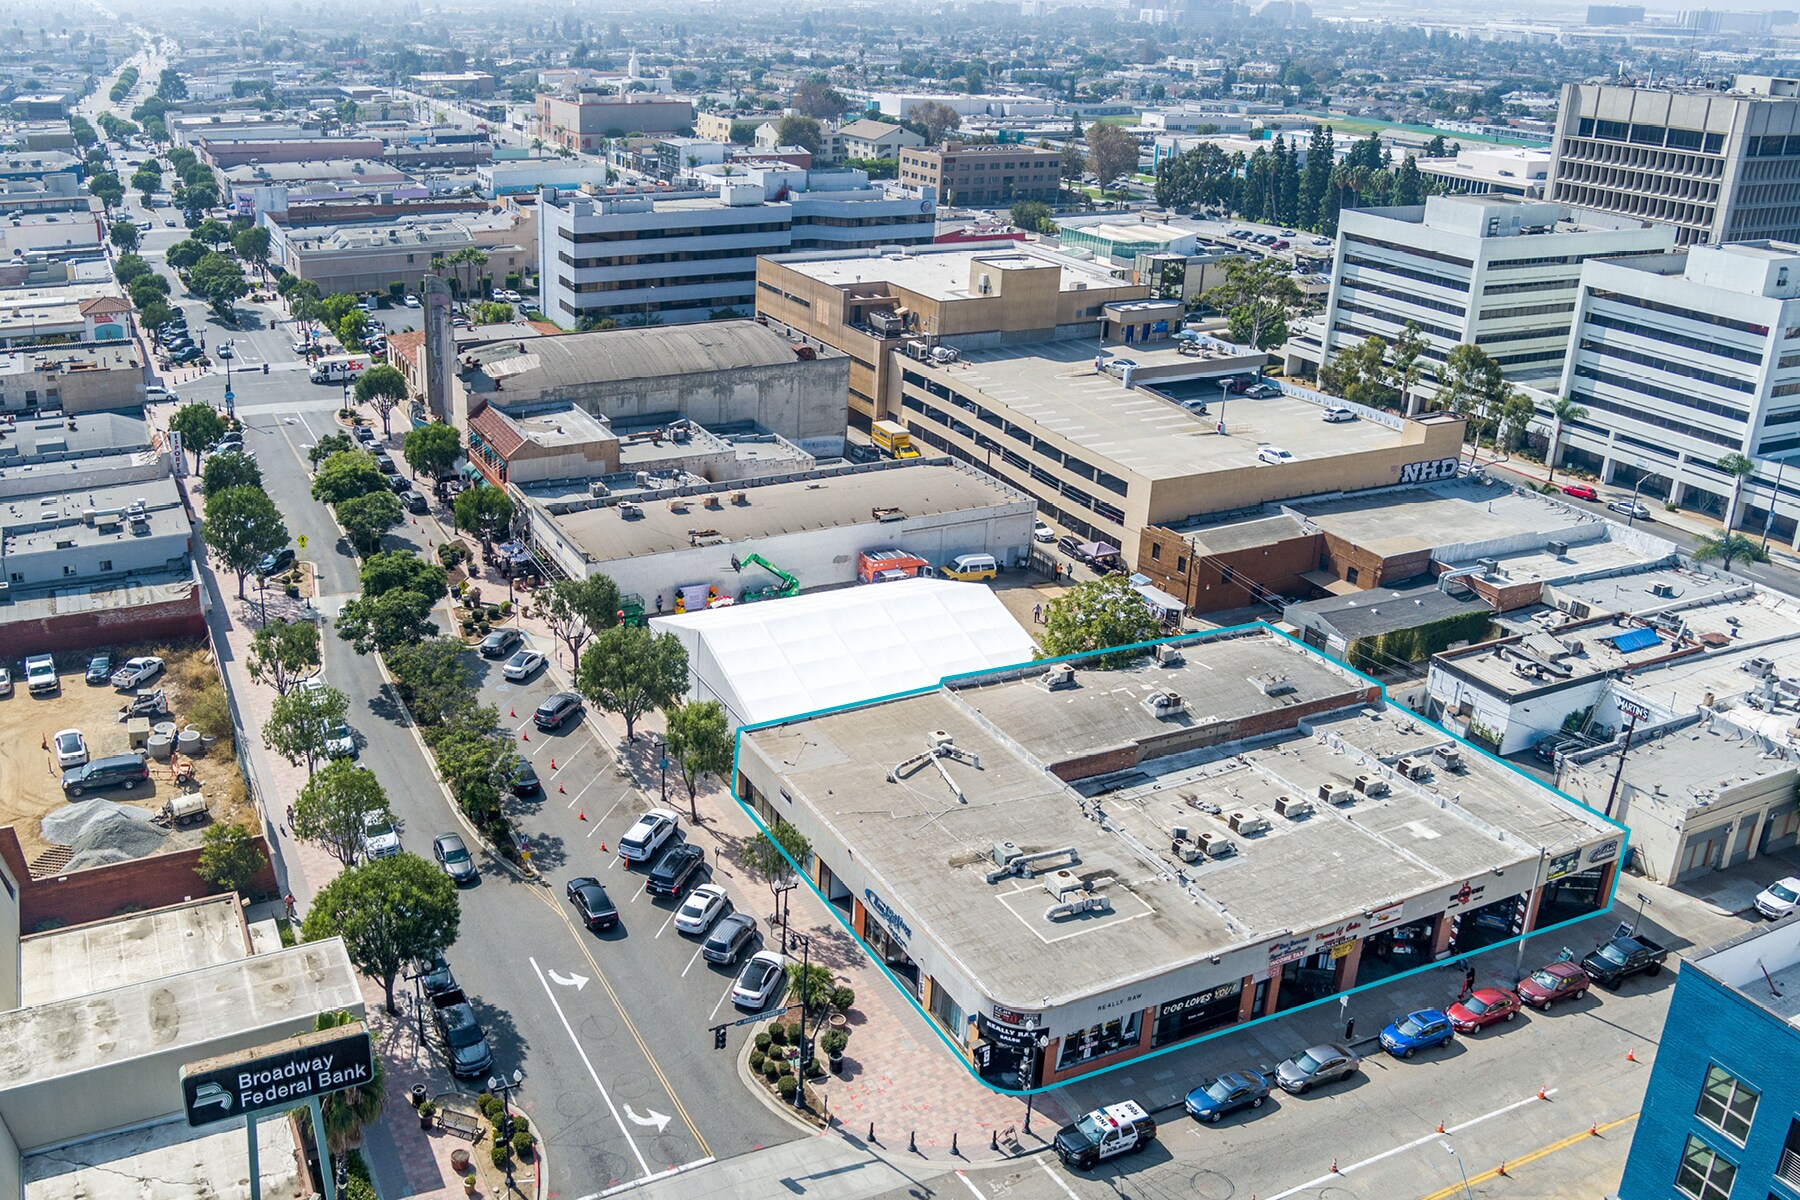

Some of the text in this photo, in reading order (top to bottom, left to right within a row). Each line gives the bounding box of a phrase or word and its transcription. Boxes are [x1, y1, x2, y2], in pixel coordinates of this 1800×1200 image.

[331, 360, 364, 372] FedEx
[1401, 457, 1459, 482] NHD
[1618, 698, 1648, 718] MARTIN'S
[1270, 954, 1291, 966] INCOME
[1292, 950, 1304, 959] TAX
[1097, 993, 1143, 1011] REALLY RAW
[1184, 993, 1212, 1008] LOVES
[986, 1020, 1015, 1037] REALLY
[1000, 1035, 1020, 1043] SALON
[238, 1054, 334, 1090] Broadway
[240, 1063, 366, 1108] Federal Bank
